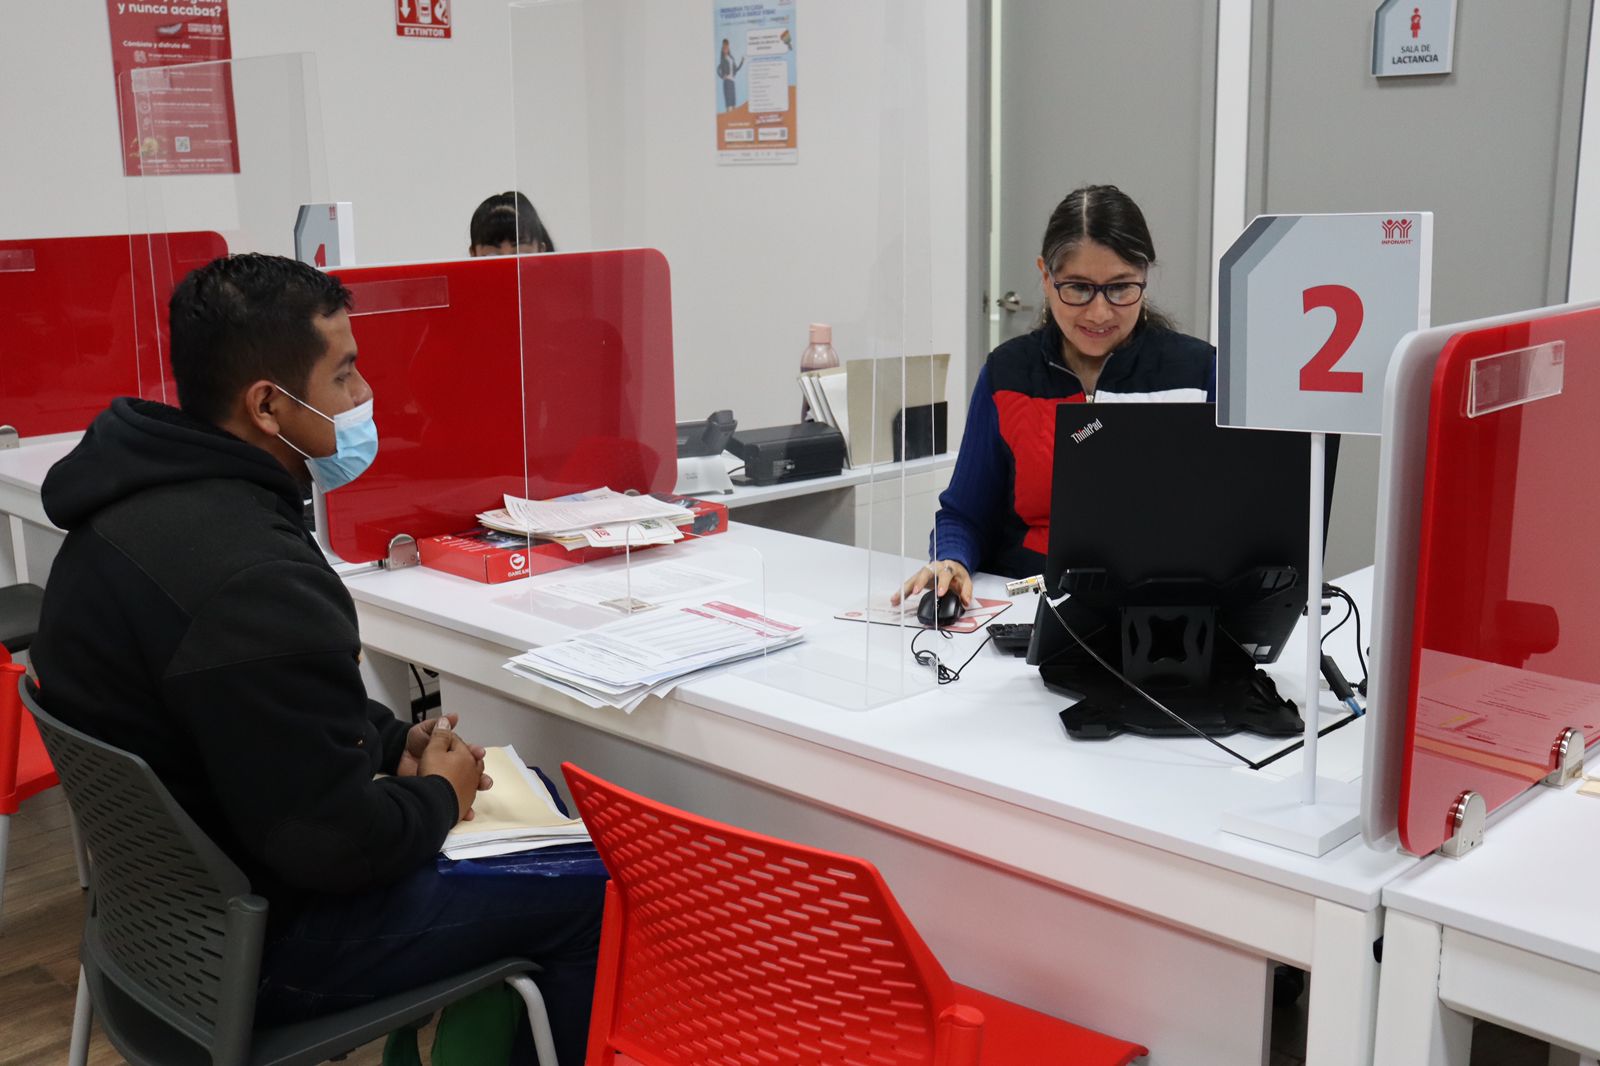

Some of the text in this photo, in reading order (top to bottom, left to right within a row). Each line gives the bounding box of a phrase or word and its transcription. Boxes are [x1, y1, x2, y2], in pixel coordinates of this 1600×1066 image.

[117, 3, 222, 17] y nunca acabas?
[404, 27, 445, 37] EXTINTOR
[1401, 44, 1431, 53] SALA DE
[1392, 54, 1439, 64] LACTANCIA
[1299, 284, 1364, 393] 2
[1070, 417, 1103, 444] ThinkPad
